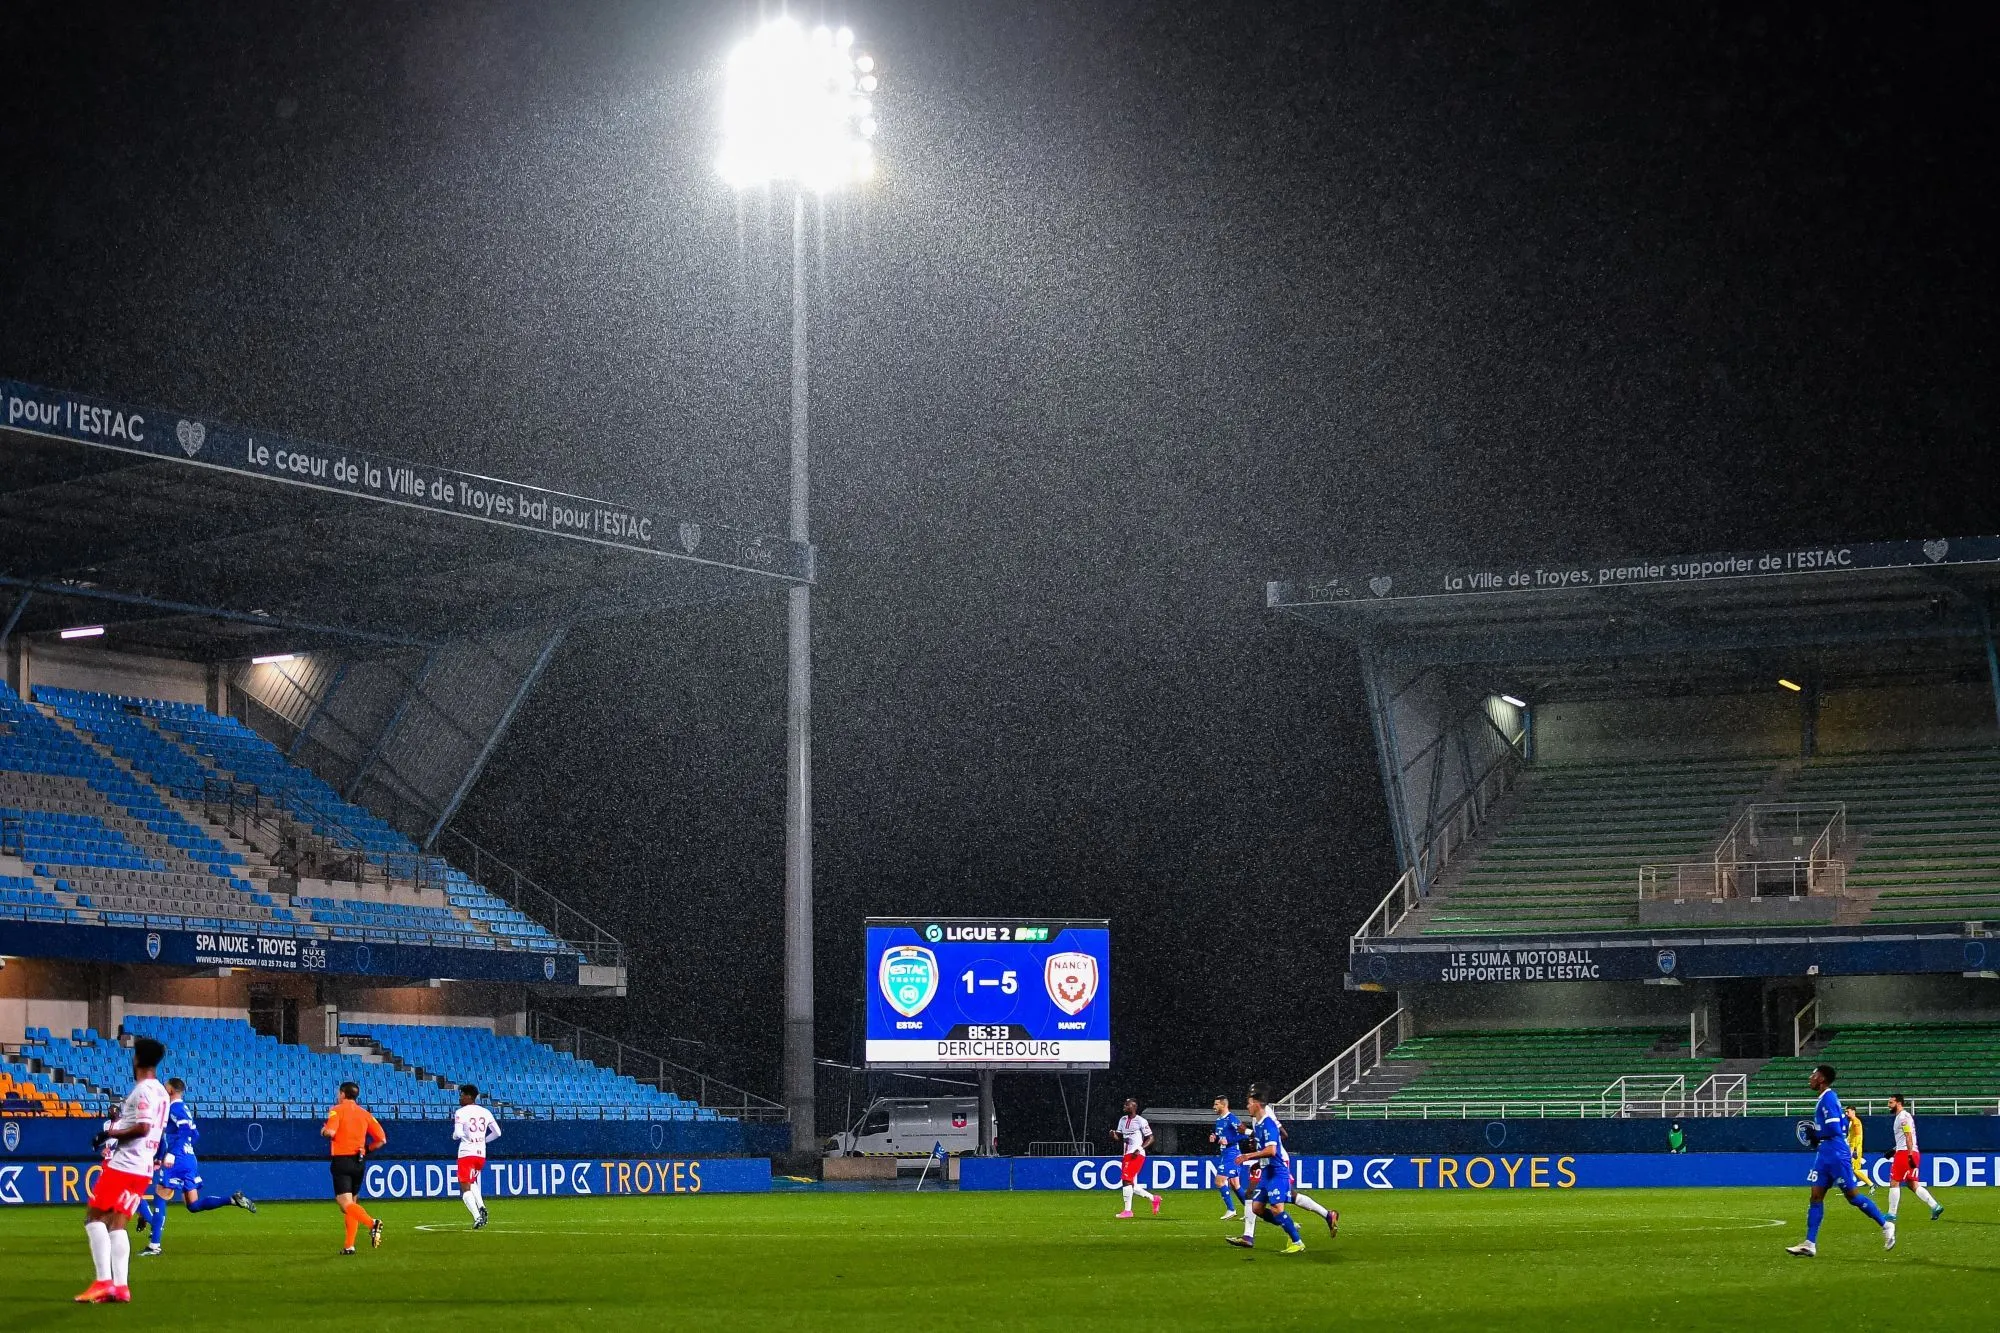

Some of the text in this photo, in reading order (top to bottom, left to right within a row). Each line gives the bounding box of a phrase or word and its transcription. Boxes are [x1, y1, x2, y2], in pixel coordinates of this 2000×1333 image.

[9, 397, 145, 442] pour l'ESTAC
[248, 438, 653, 541] Le cœur de la Ville de Troyes bat pour l'ESTAC
[1444, 548, 1852, 590] La Ville de Troyes, premier supporter de l'ESTAC
[946, 926, 997, 941] LIGUE
[999, 927, 1011, 940] 2
[196, 934, 216, 951] SPA
[219, 936, 249, 953] NUXE
[257, 938, 297, 956] TROYES
[302, 948, 326, 956] NUXE
[302, 954, 326, 971] spa
[1054, 961, 1089, 970] NANCY
[1451, 950, 1593, 967] LE SUMA MOTOBALL
[1441, 965, 1600, 981] SUPPORTER DE L'ESTAC
[896, 1021, 923, 1030] ESTAC
[968, 1025, 1009, 1040] 86:33
[1057, 1021, 1087, 1030] NANCY
[937, 1041, 1060, 1057] DERICHEBOURG
[469, 1116, 486, 1133] 33
[366, 1161, 701, 1198] GOLDE TULIP TROYES
[1410, 1156, 1577, 1189] TROYES
[37, 1165, 175, 1202] TRO
